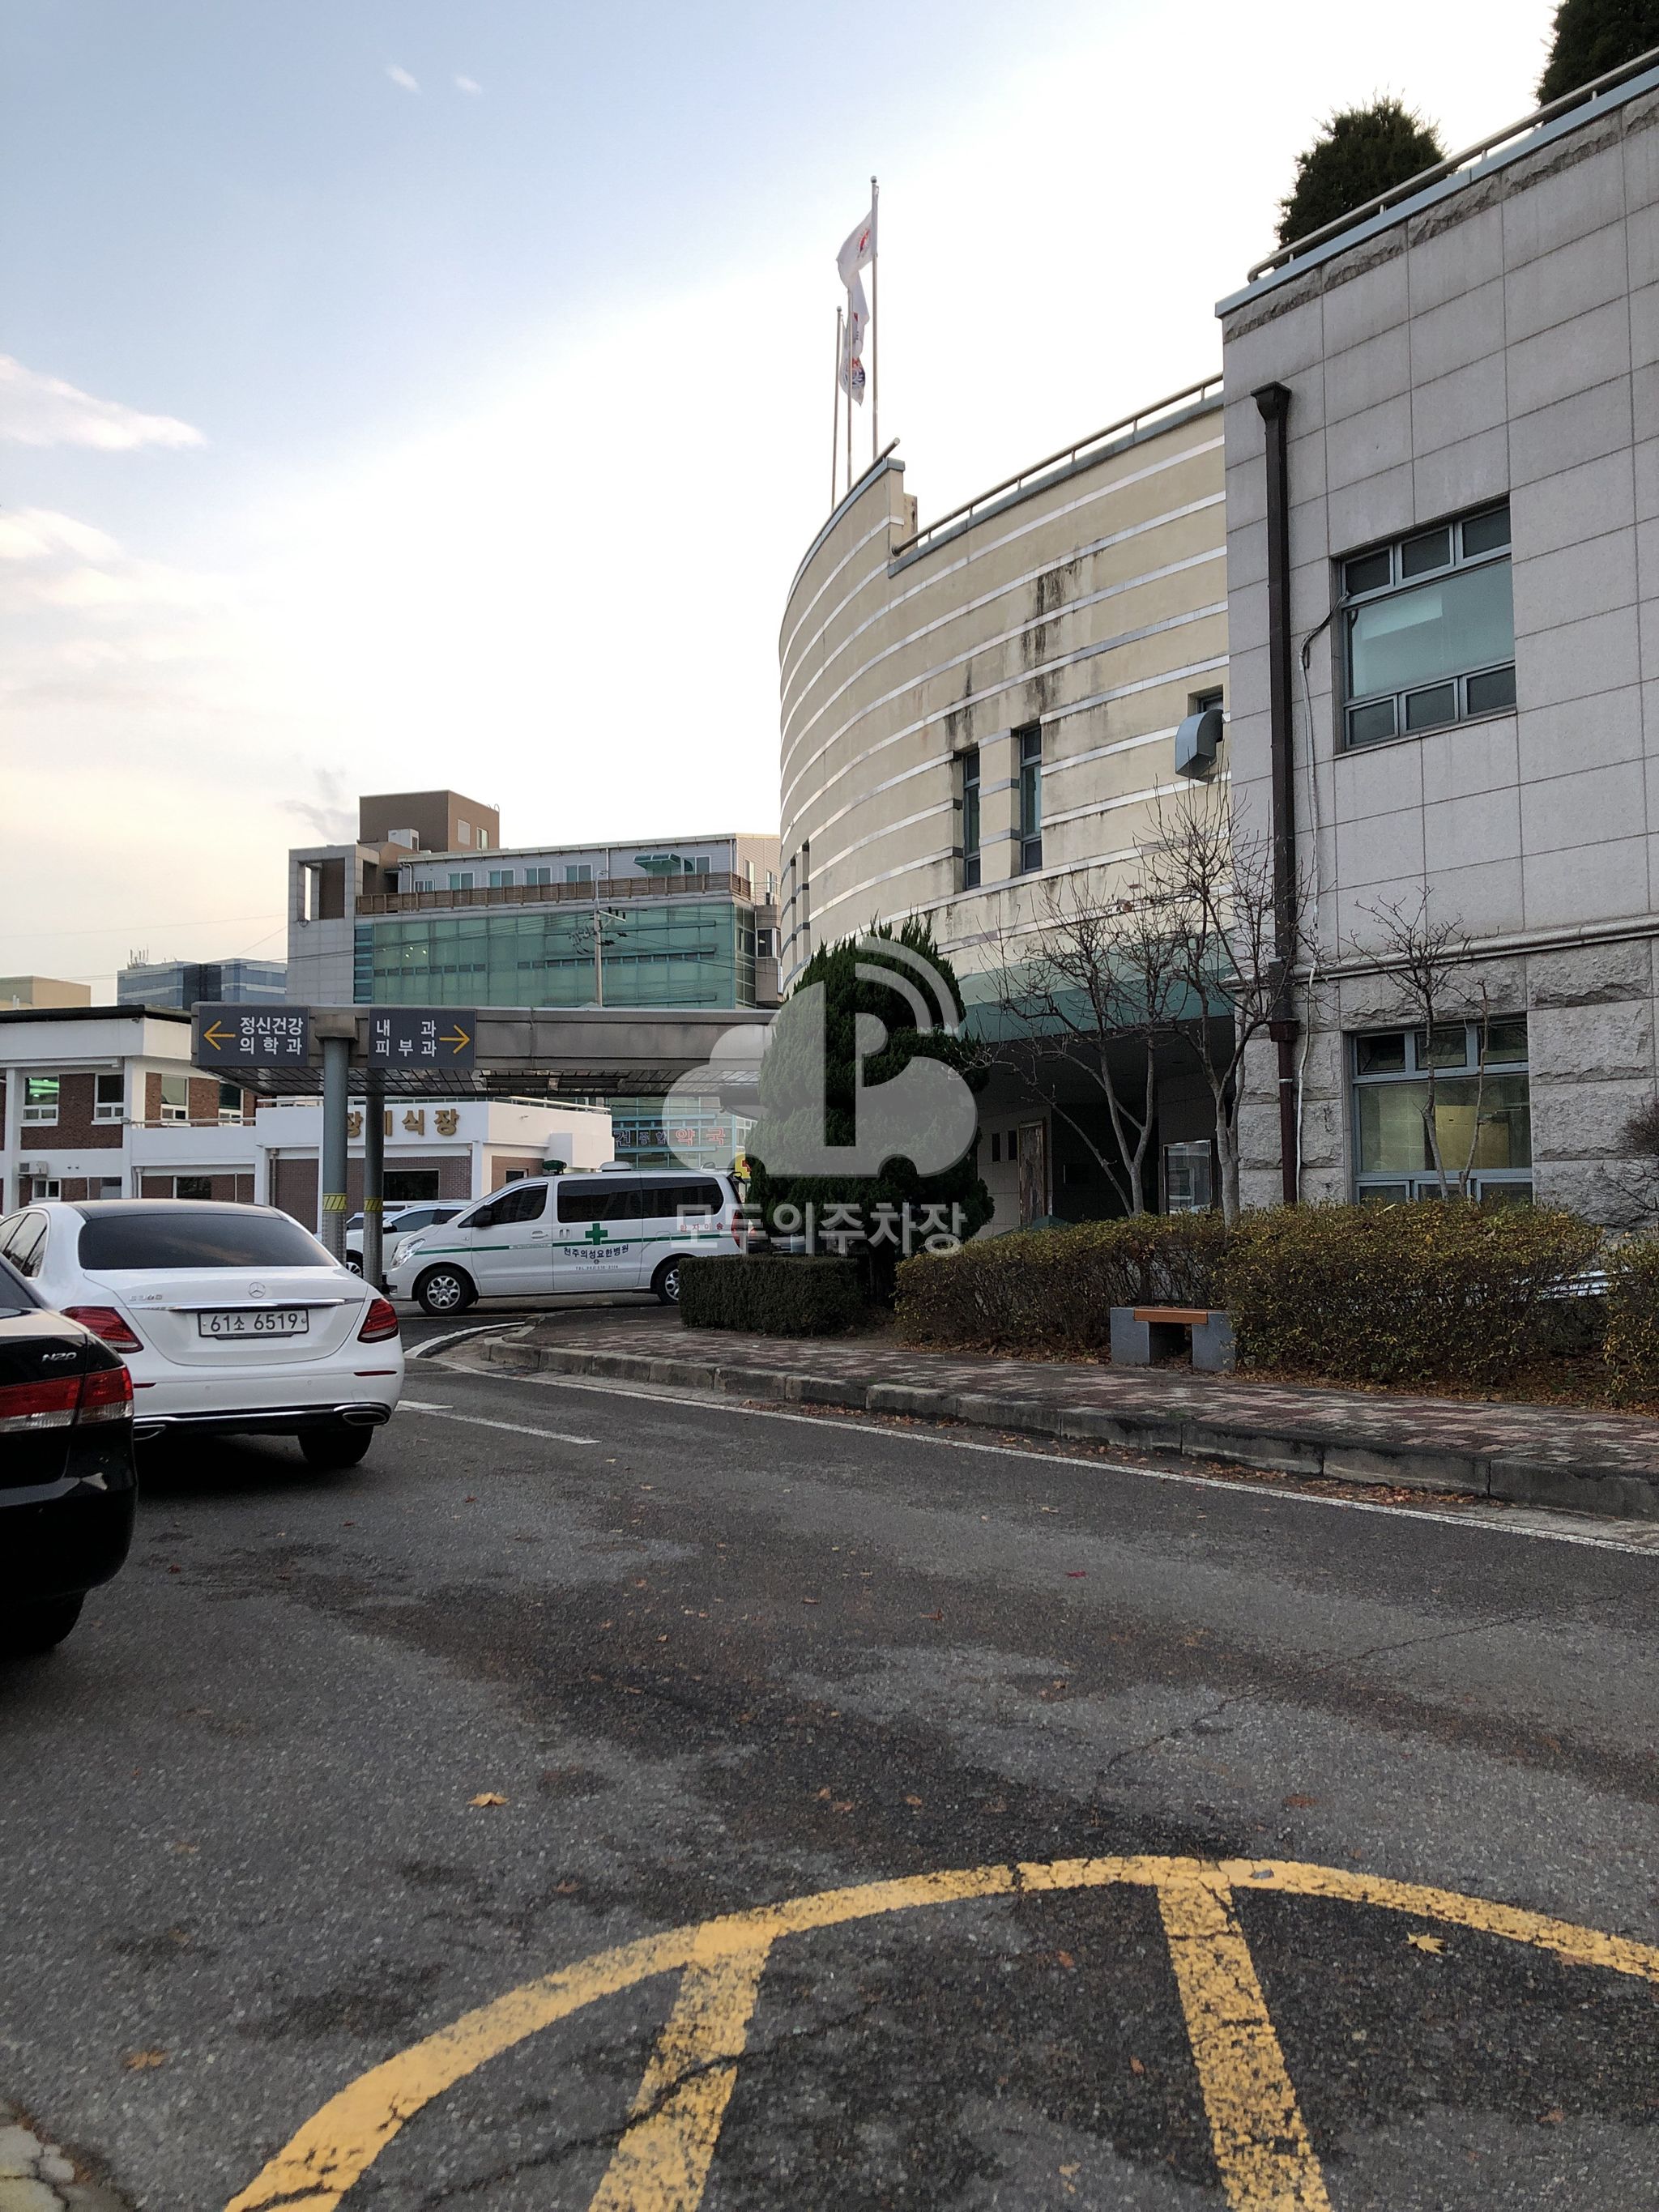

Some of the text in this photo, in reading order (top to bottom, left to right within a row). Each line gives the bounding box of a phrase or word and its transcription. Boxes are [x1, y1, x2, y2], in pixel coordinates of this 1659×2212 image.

[240, 1016, 304, 1036] 정신건강
[210, 1313, 298, 1332] 61소 6519
